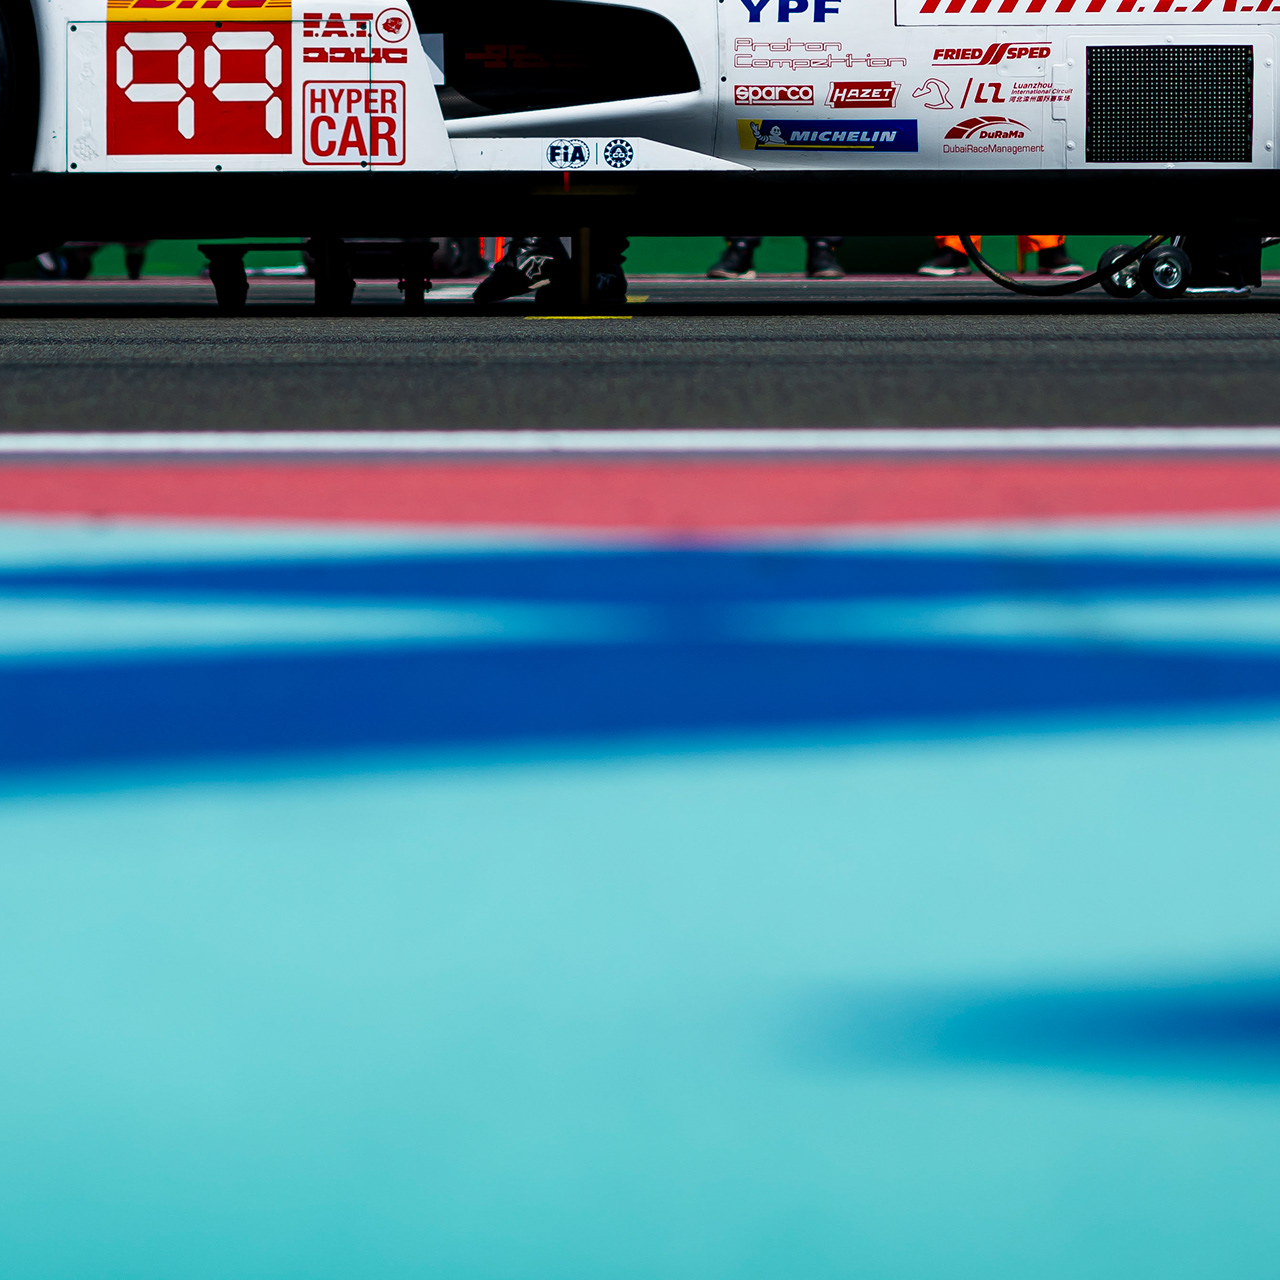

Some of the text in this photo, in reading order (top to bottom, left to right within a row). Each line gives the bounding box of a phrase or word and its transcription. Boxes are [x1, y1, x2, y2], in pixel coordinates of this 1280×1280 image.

[734, 37, 842, 53] Proton
[933, 46, 1052, 60] FRIED SPED
[734, 53, 907, 71] Competition
[116, 31, 282, 140] 99
[1013, 81, 1053, 89] Luanzhou
[310, 89, 397, 113] HYPER
[735, 86, 814, 104] sparco
[832, 87, 893, 102] HAZET
[310, 116, 397, 157] CAR
[790, 130, 898, 143] MICHELIN
[979, 131, 1024, 139] DuRaMa
